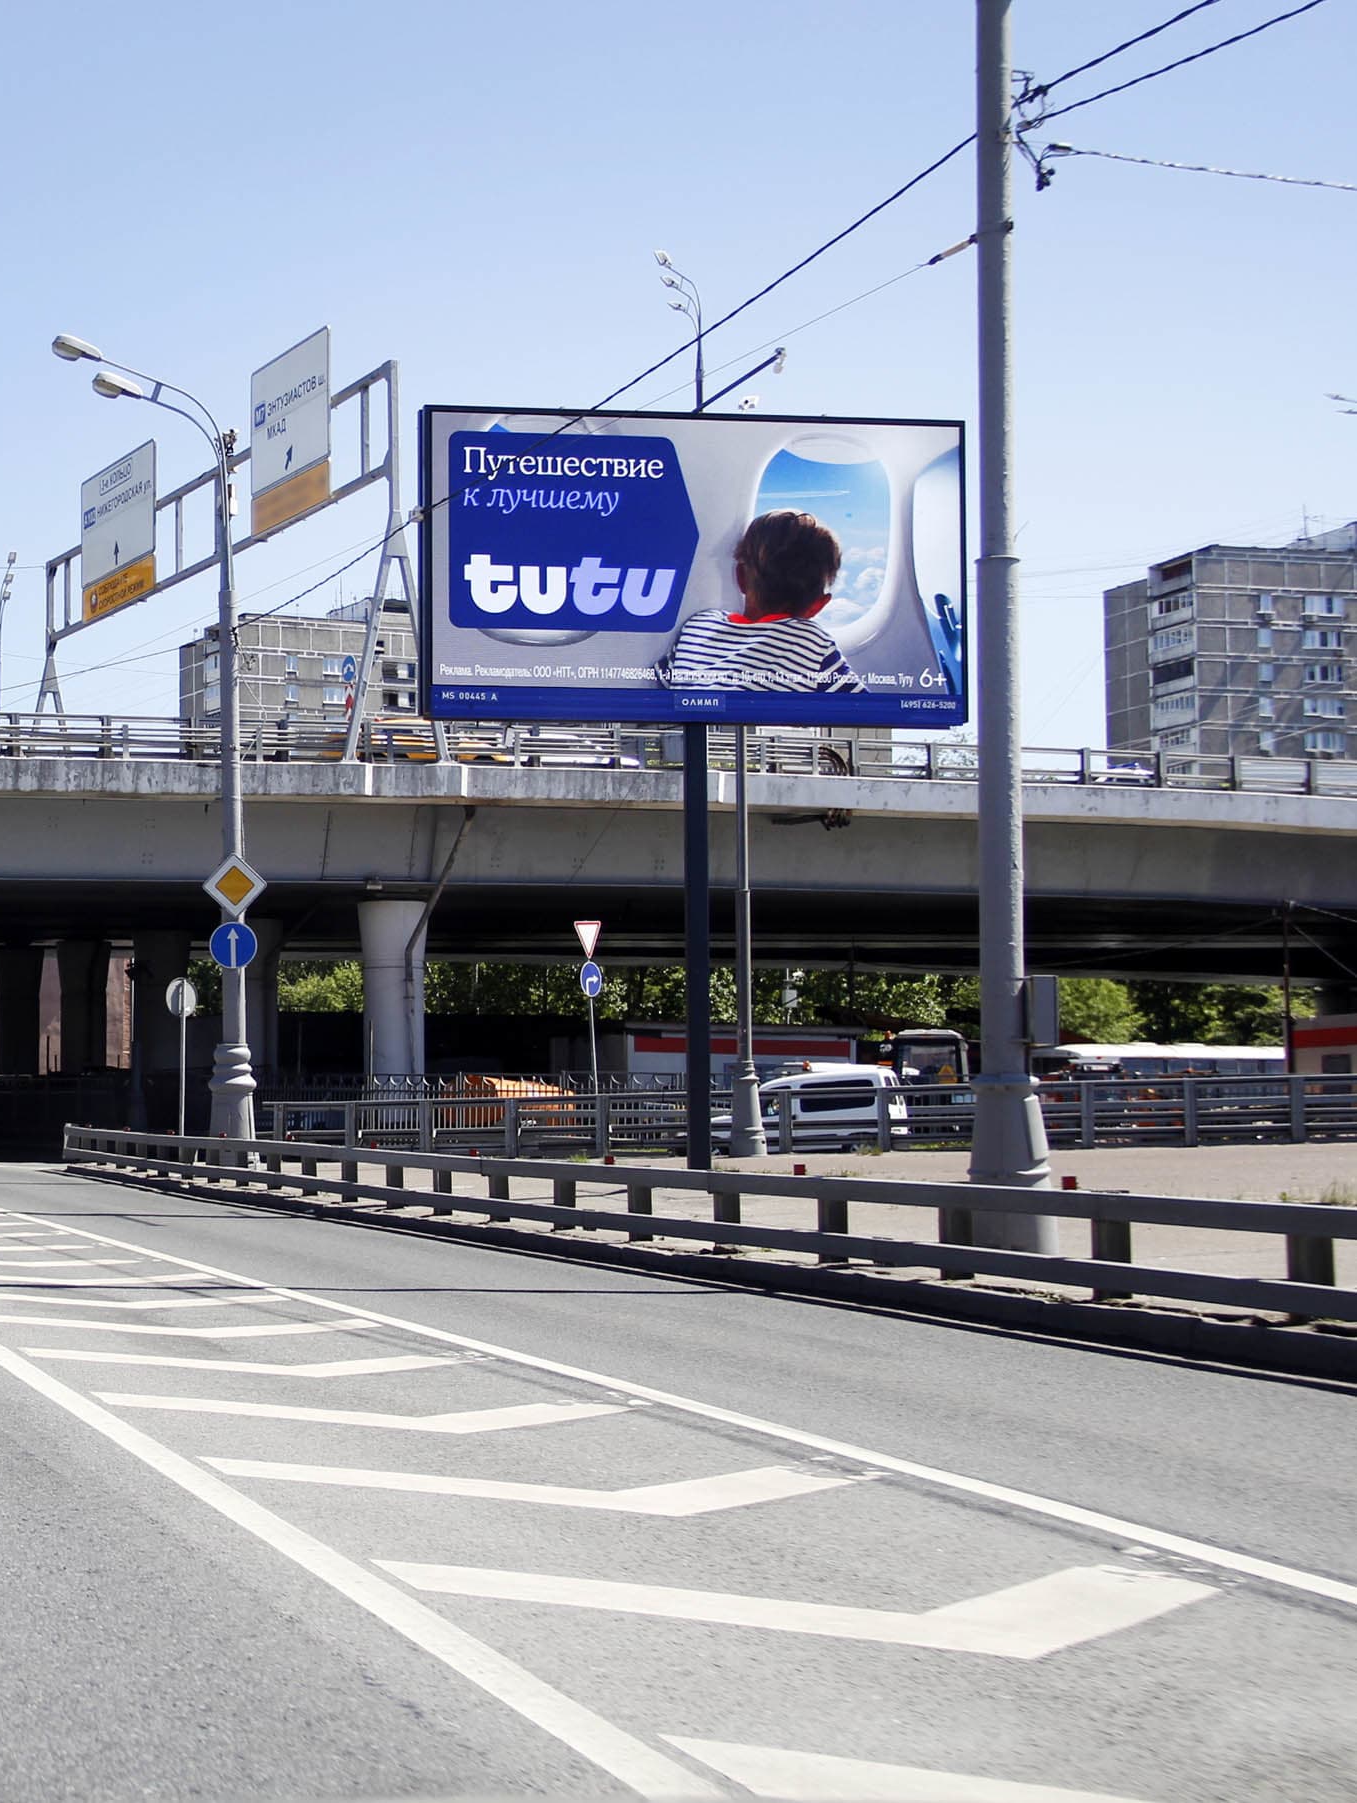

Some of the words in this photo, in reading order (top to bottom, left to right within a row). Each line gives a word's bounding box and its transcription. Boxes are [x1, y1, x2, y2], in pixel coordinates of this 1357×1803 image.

[267, 375, 316, 417] ЭНТУЗИАСТОВ
[267, 418, 287, 440] МКАД
[110, 462, 132, 485] КОЛЬЦО
[463, 446, 664, 480] Путешествие
[97, 481, 143, 518] НИЖЕГОРОДСКАЯ
[463, 488, 480, 507] к
[486, 488, 620, 517] лучшему
[464, 554, 676, 617] tutu
[533, 665, 552, 678] ООО
[578, 666, 599, 679] ОГРН
[919, 668, 947, 688] 6+
[442, 691, 455, 700] MS
[459, 691, 486, 701] 00445
[682, 698, 719, 706] ОЛИМП
